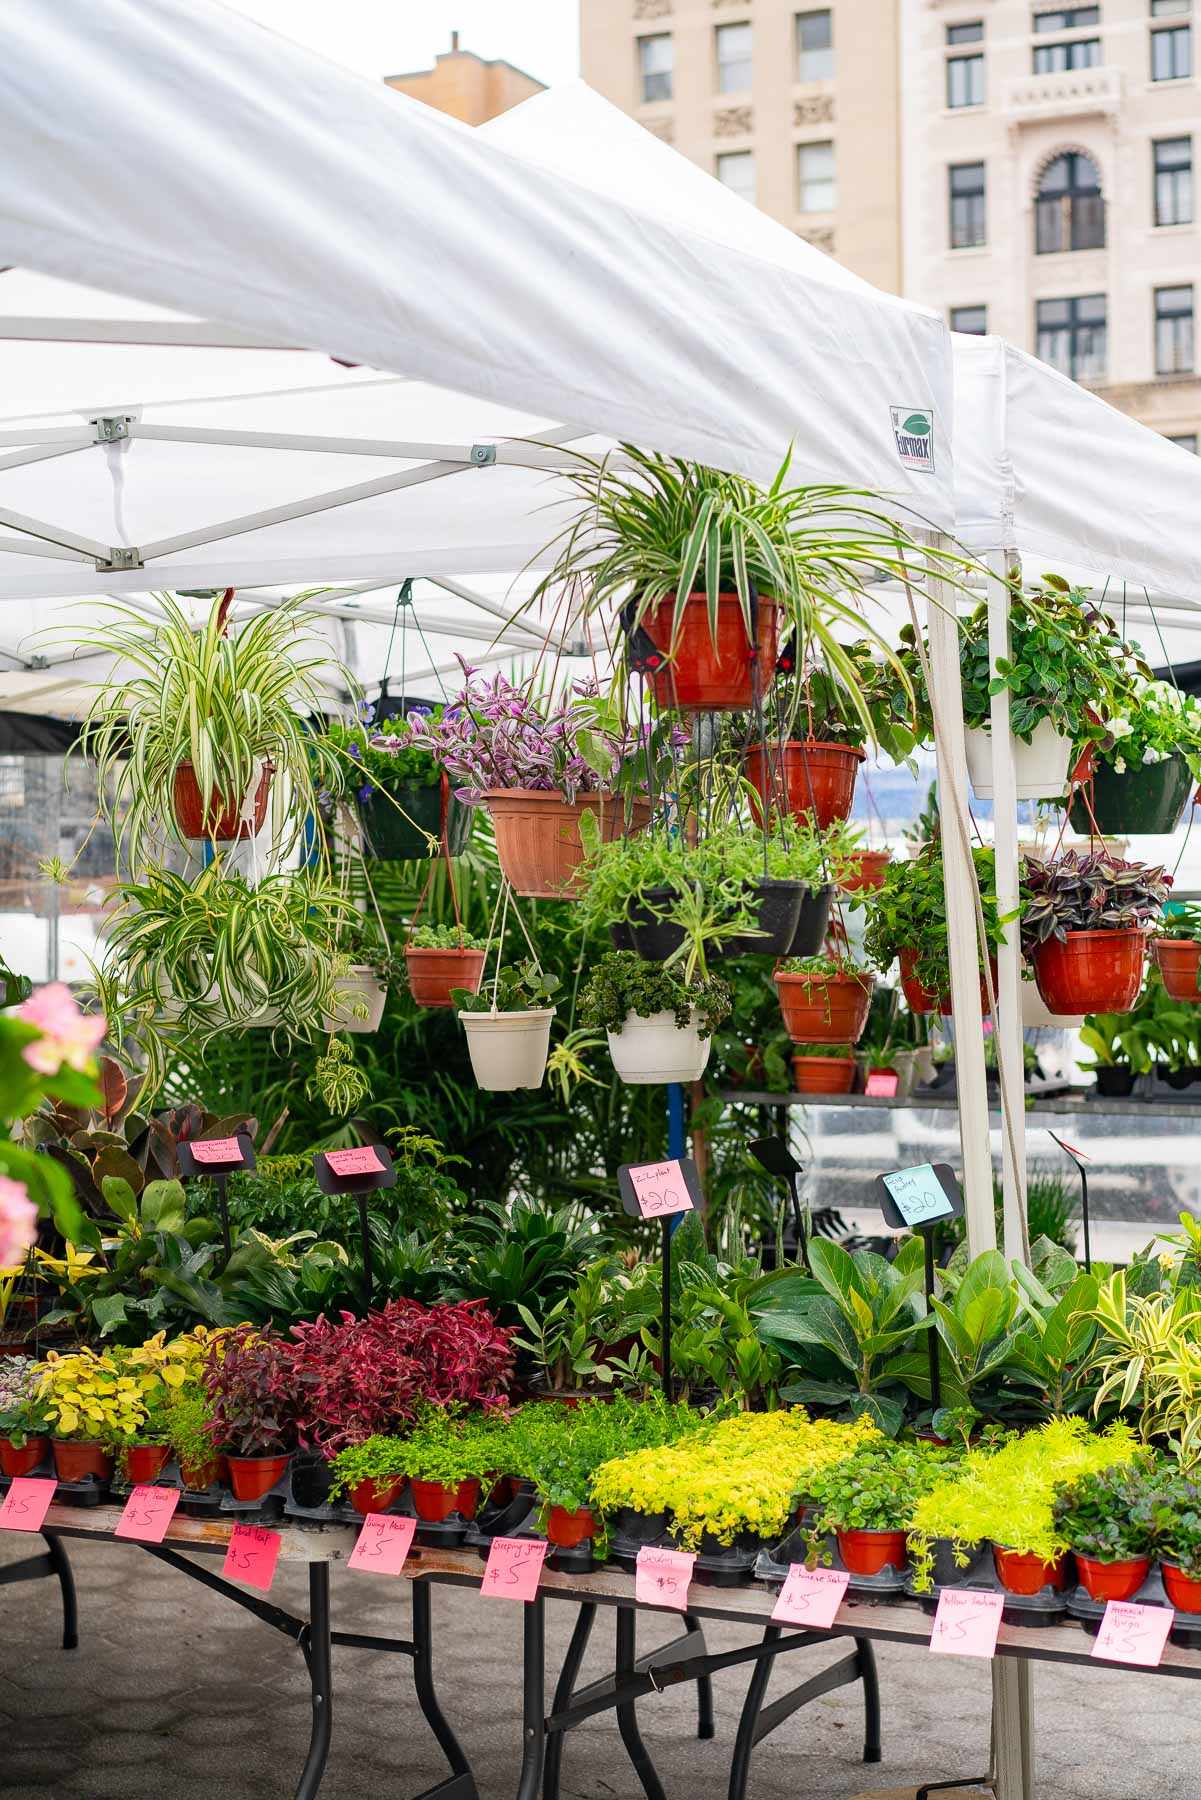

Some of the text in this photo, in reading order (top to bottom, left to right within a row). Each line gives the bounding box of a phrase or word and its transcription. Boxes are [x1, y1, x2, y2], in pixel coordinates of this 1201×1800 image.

[895, 430, 930, 460] Eurmax
[640, 1188, 680, 1210] $20
[901, 1191, 937, 1214] $20
[655, 1576, 677, 1594] $5
